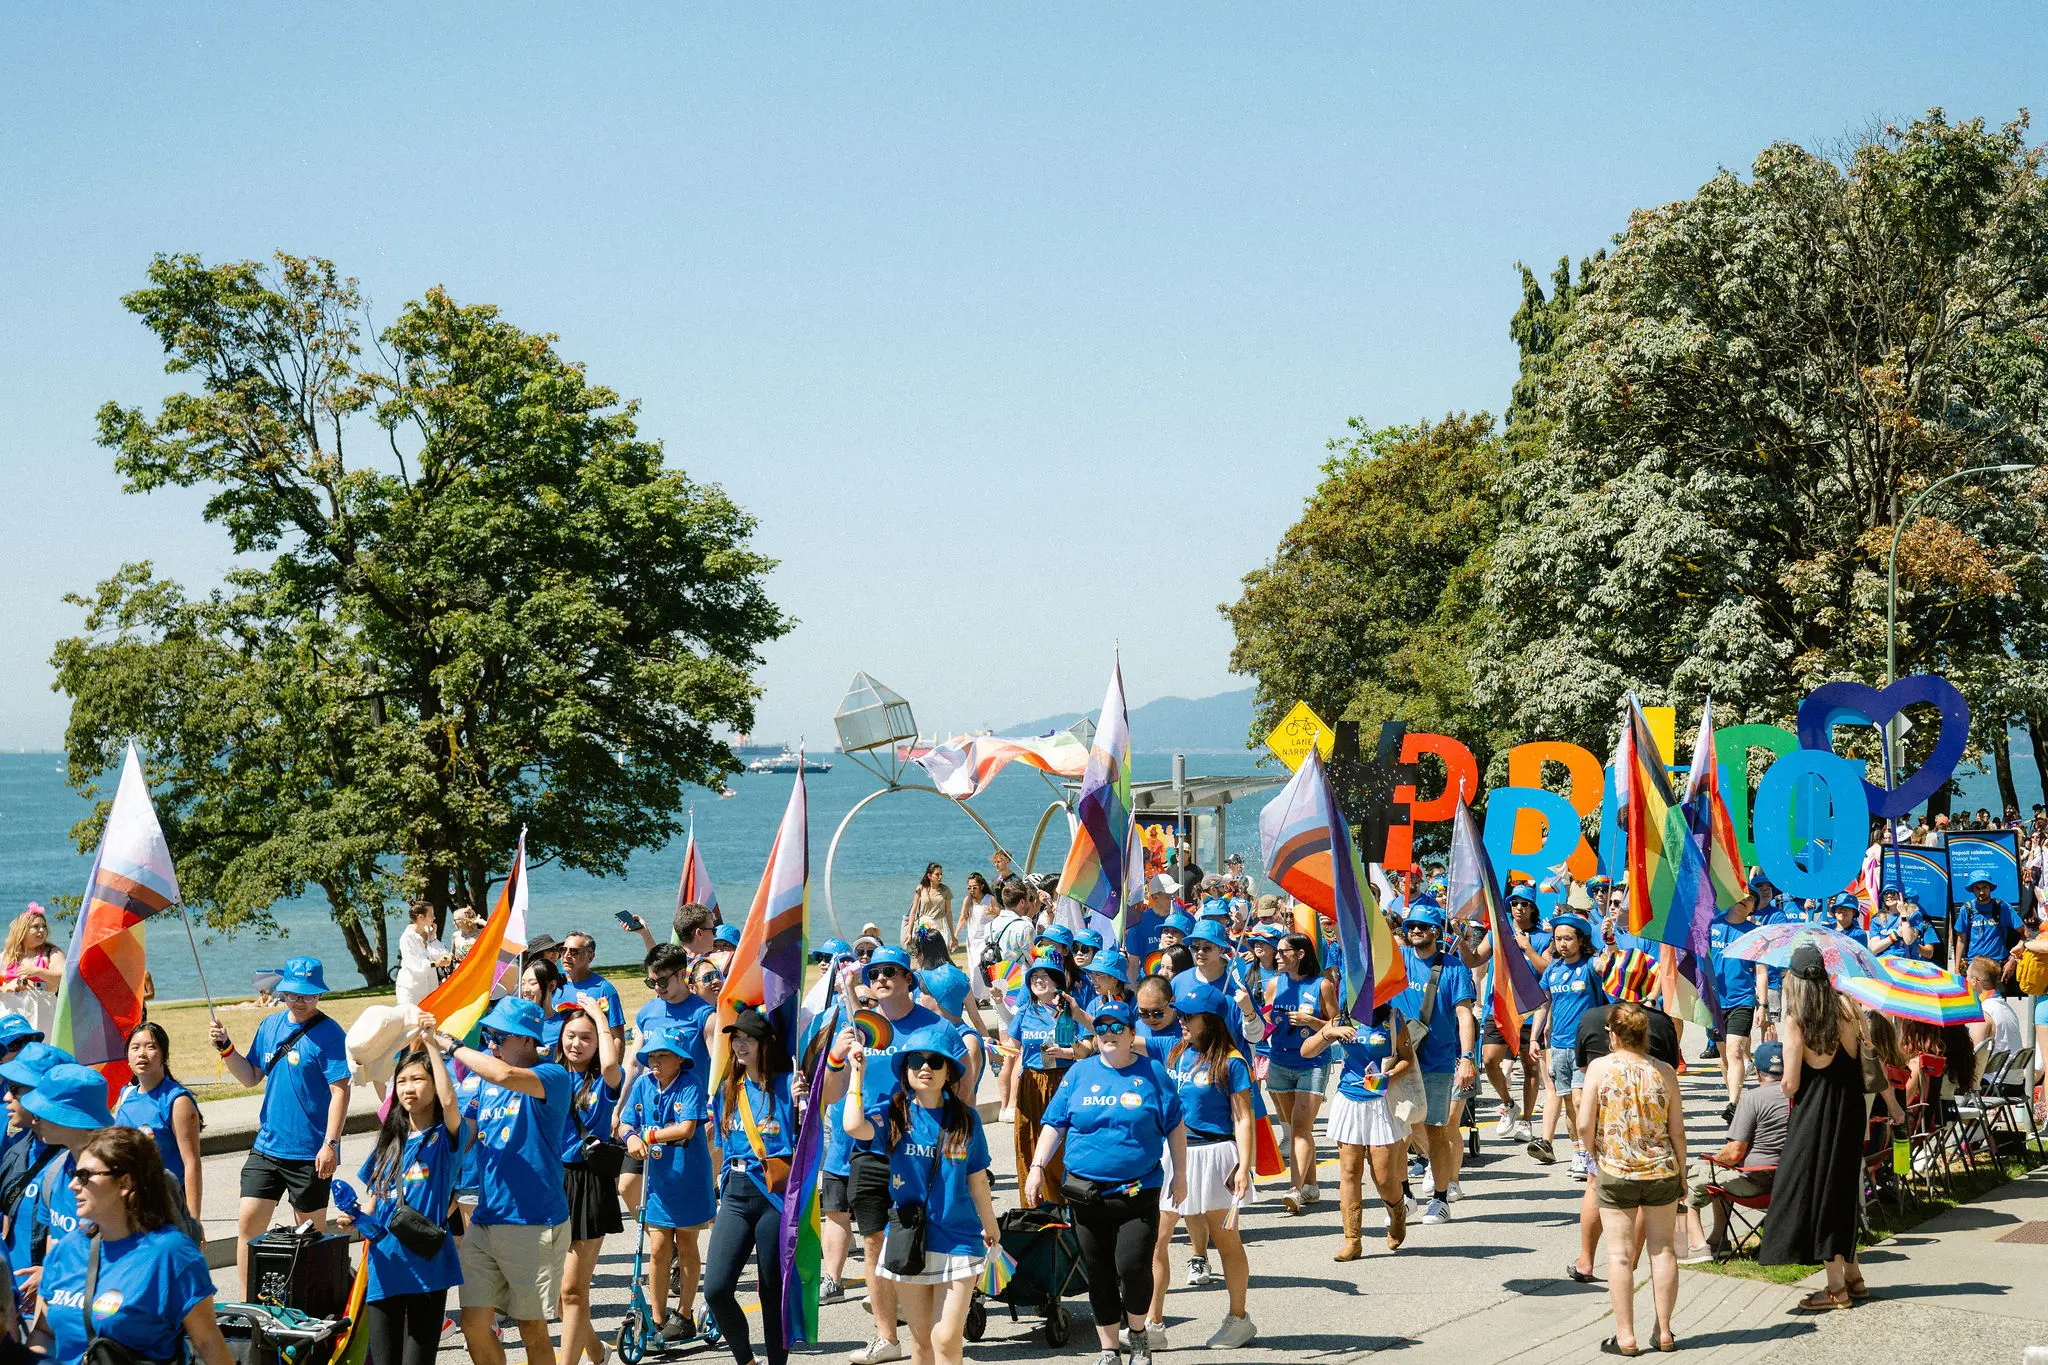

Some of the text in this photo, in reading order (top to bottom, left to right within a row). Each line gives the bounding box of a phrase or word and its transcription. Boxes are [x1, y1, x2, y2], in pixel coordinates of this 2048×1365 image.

[1291, 738, 1312, 746] LANE
[1282, 748, 1324, 756] NARROS
[1148, 936, 1161, 944] BM
[1408, 981, 1421, 991] MO
[1549, 984, 1570, 994] BMO
[1022, 1030, 1047, 1039] BMO
[863, 1045, 898, 1057] BMO
[1081, 1095, 1117, 1106] BMO
[479, 1106, 506, 1121] BMO
